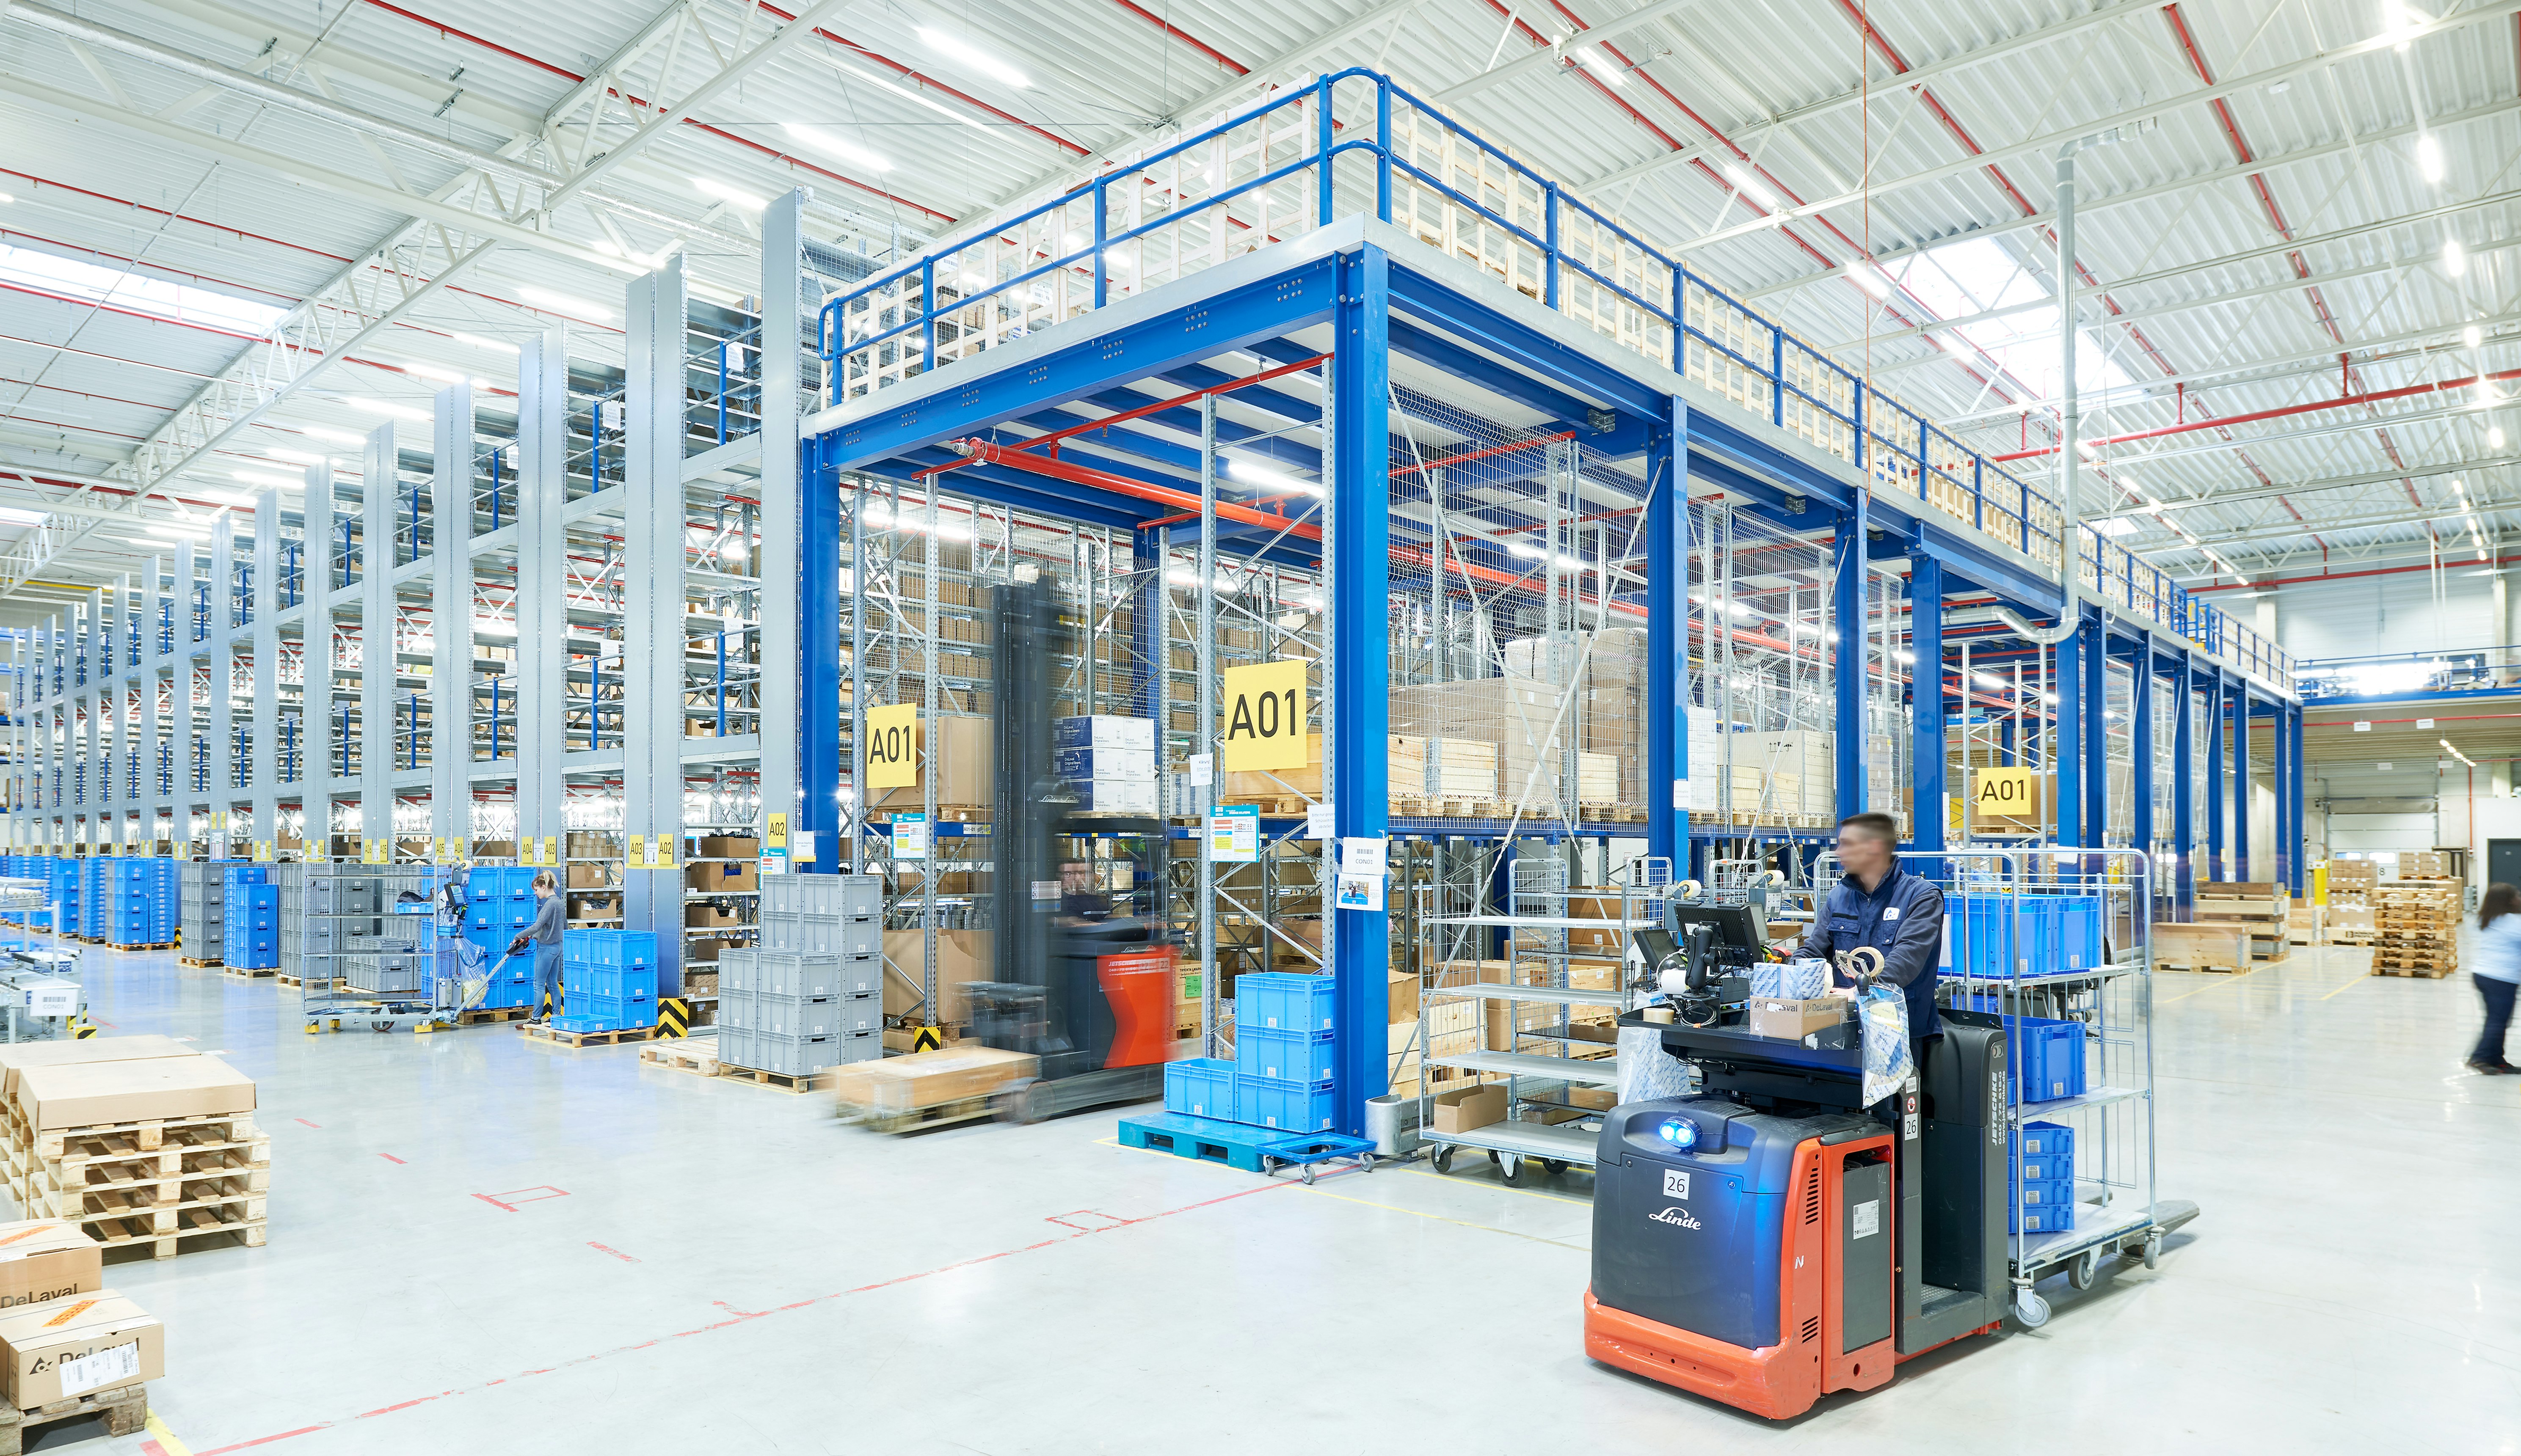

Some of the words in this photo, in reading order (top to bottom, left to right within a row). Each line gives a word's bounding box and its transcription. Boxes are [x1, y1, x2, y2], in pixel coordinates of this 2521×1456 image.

[1228, 689, 1296, 740] A01
[869, 726, 910, 764] A01
[1981, 779, 2025, 801] A01
[769, 822, 784, 836] A02
[522, 844, 532, 854] A04
[545, 844, 555, 854] A03
[630, 842, 643, 854] A03
[659, 842, 671, 854] A02
[1765, 1002, 1798, 1012] aval
[1812, 1003, 1833, 1012] DeLaval
[1998, 1102, 2002, 1116] 75
[1906, 1120, 1917, 1134] 26
[1668, 1176, 1685, 1193] 26
[1648, 1206, 1701, 1230] Linde
[1, 1283, 77, 1309] DeLaval
[49, 1300, 96, 1325] EXPRESS
